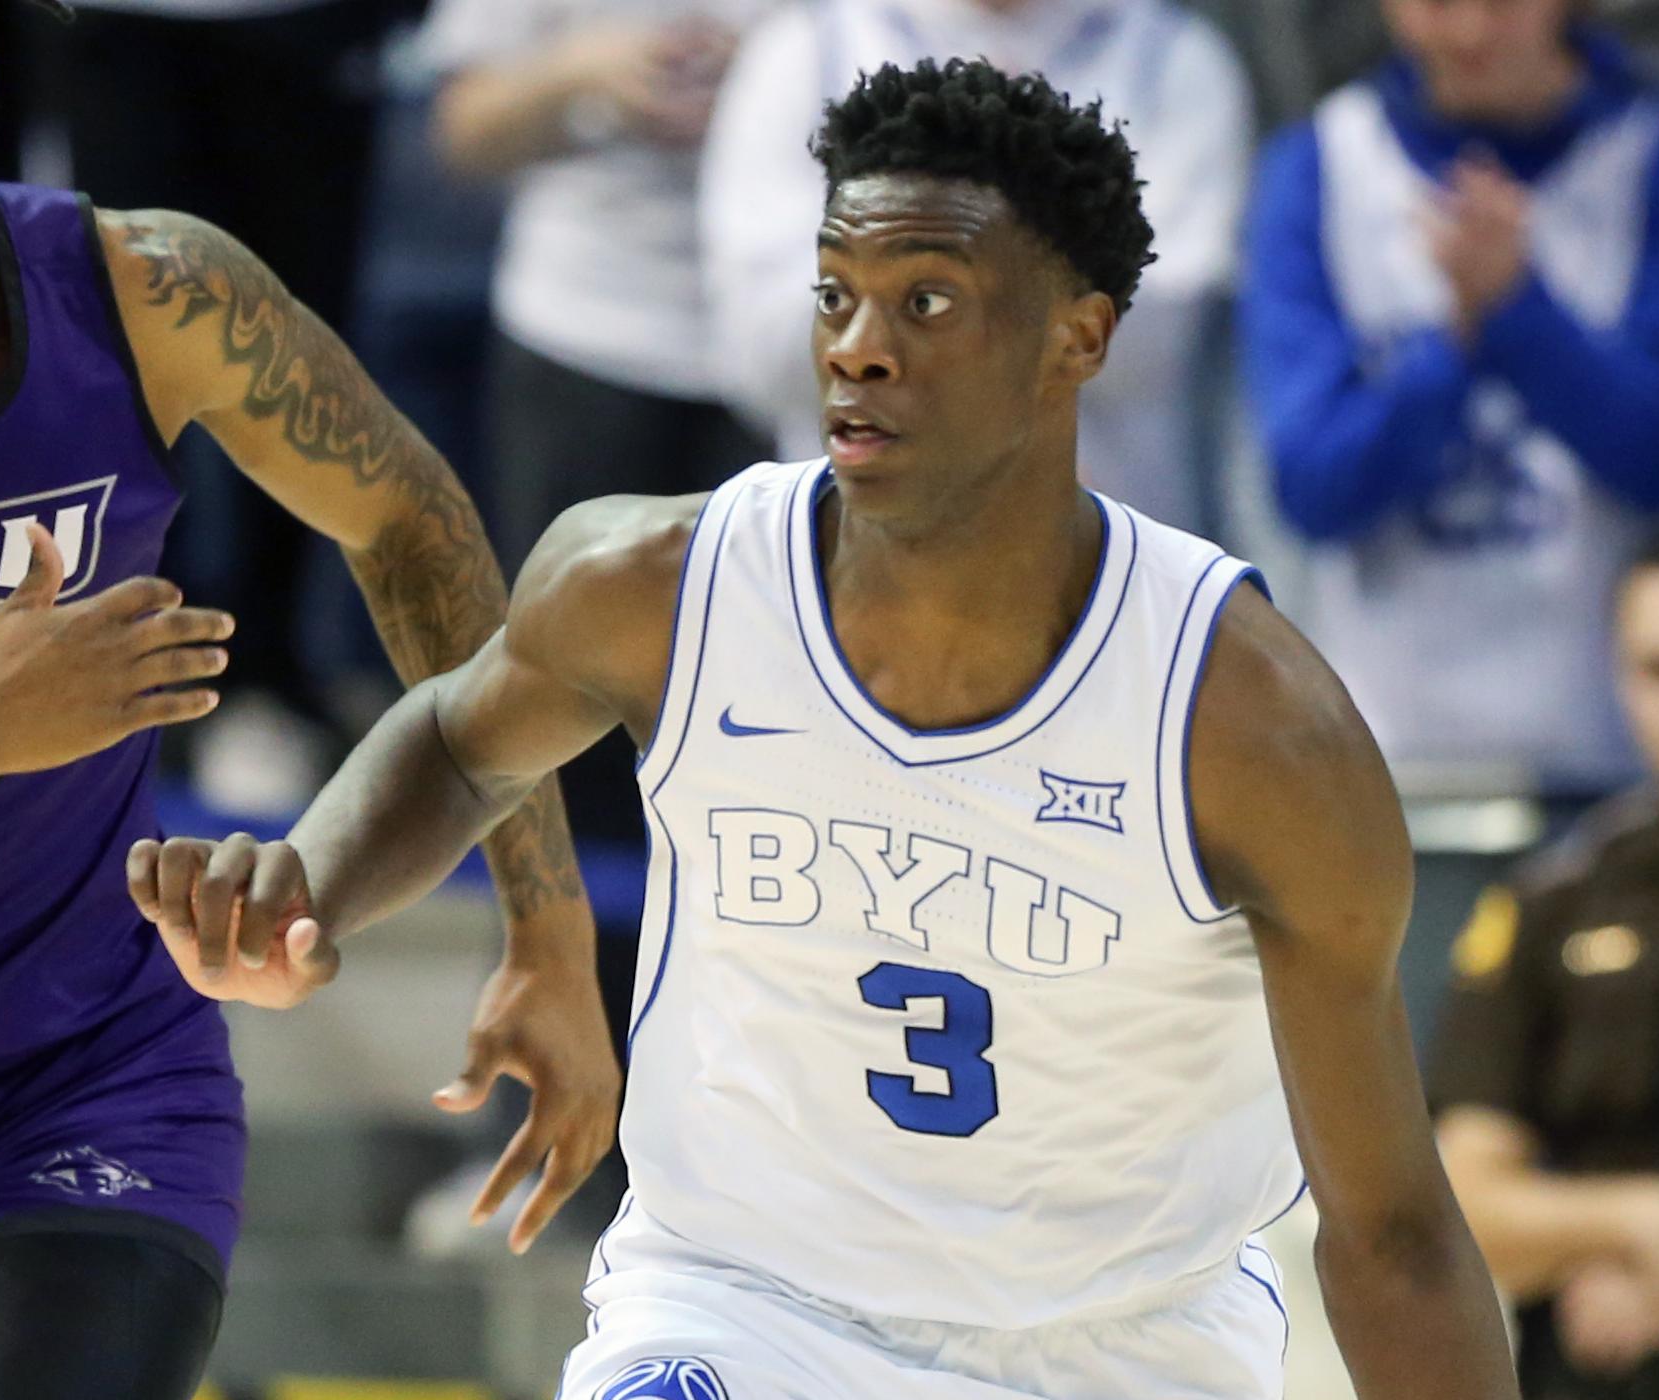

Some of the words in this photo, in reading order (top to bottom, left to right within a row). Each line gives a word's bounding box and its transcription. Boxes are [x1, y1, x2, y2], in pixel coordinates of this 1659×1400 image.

[1034, 767, 1127, 835] XII
[708, 807, 1123, 979] BYU
[856, 960, 1000, 1139] 3
